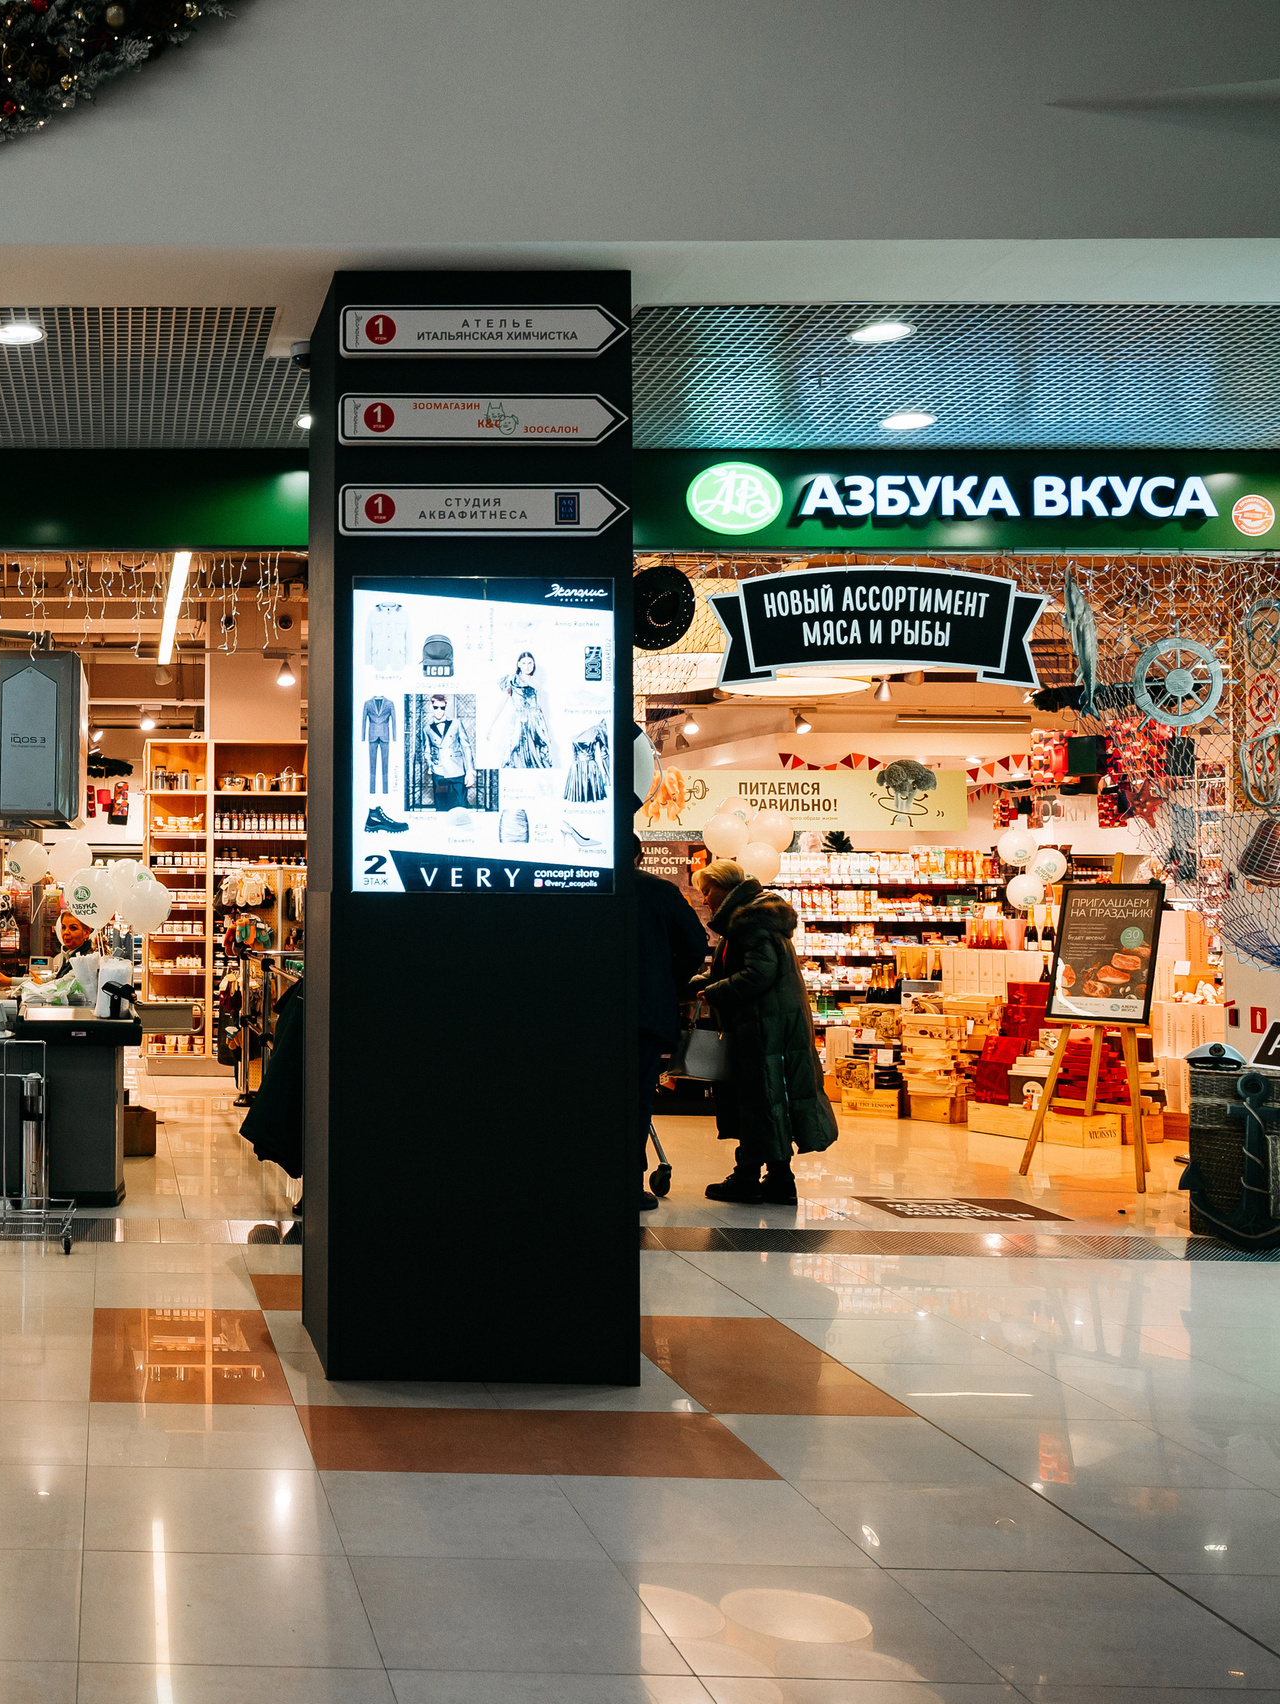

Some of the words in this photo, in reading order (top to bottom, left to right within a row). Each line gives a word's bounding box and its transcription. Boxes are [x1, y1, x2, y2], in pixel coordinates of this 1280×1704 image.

[374, 317, 383, 335] 1
[461, 319, 534, 328] АТЕЛЬЕ
[417, 331, 503, 341] ИТАЛЬЯНСКАЯ
[506, 331, 578, 340] ХИМЧИСТКА
[413, 402, 481, 410] ЗООМАГАЗИН
[373, 405, 382, 422] 1
[523, 426, 579, 434] ЗООСАЛОН
[801, 475, 1021, 517] АЗБУКА
[1034, 476, 1219, 518] ВКУСА
[374, 496, 383, 514] 1
[445, 498, 501, 507] СТУДИЯ
[419, 511, 528, 520] АКВАФИТНЕСА
[763, 583, 834, 619] НОВЫЙ
[841, 587, 989, 618] АССОРТИМЕНТ
[802, 621, 861, 647] МЯСА
[869, 621, 882, 645] И
[890, 620, 951, 648] РЫБЫ
[10, 736, 37, 744] IQOS
[40, 736, 46, 744] 3
[738, 782, 820, 796] ПИТАЕМСЯ
[743, 798, 838, 812] РАВИЛЬНО!
[364, 855, 387, 875] 2
[661, 857, 702, 865] ОСТРЫХ
[420, 867, 521, 888] VERY
[534, 869, 574, 880] concept
[575, 869, 600, 878] store
[363, 878, 389, 886] ЭТАЖ
[1071, 898, 1150, 909] ПРИГЛАШАЕМ
[1070, 908, 1090, 918] НА
[1089, 908, 1154, 919] ПРАЗДНИК!
[1125, 929, 1140, 940] 30
